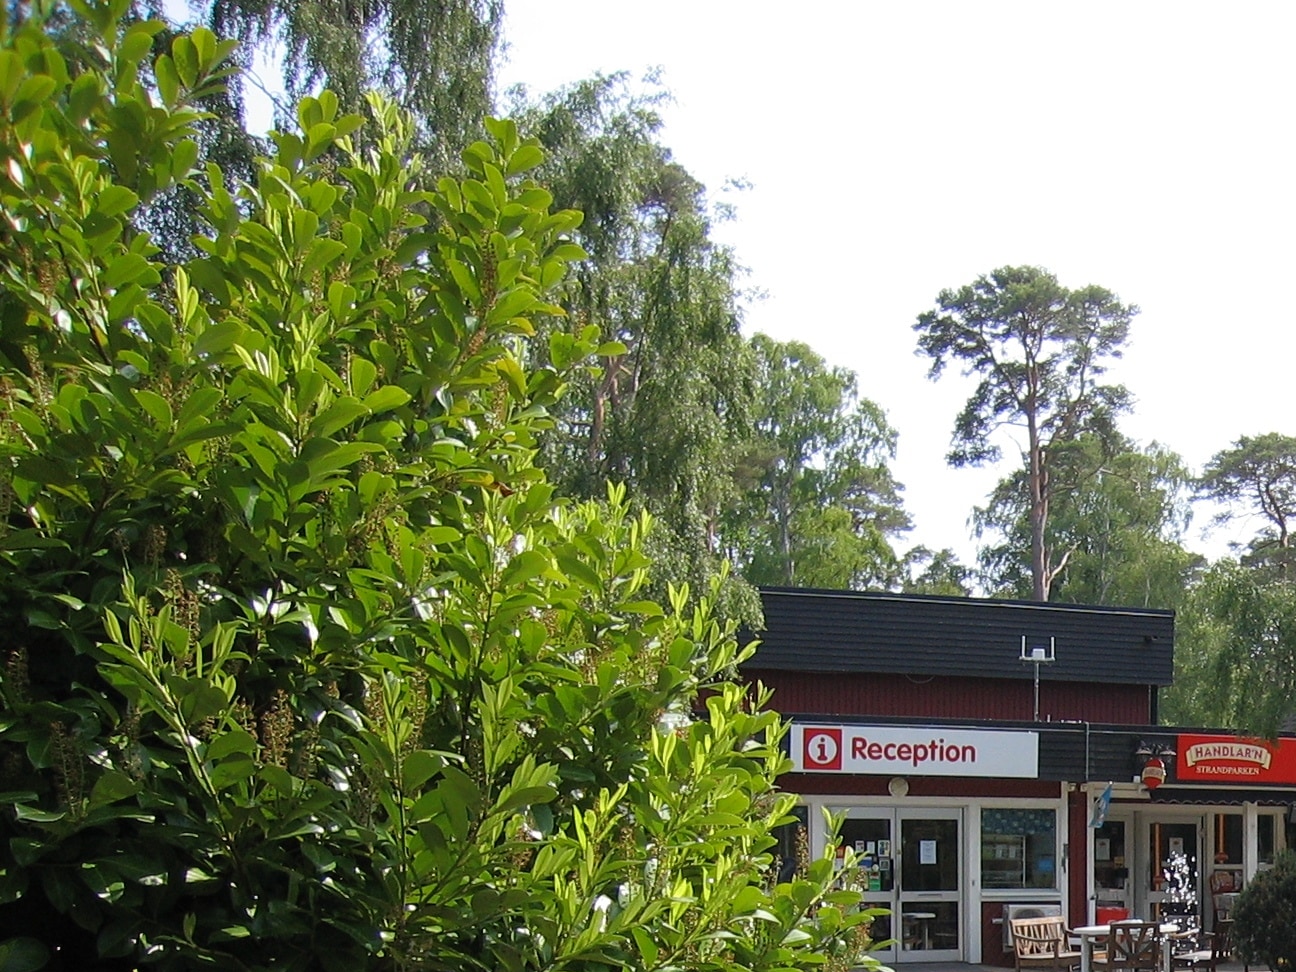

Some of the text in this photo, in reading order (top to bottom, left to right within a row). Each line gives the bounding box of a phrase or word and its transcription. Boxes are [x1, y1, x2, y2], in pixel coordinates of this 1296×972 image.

[851, 736, 976, 767] Reception
[1195, 746, 1263, 760] HANDLAR'N
[1195, 765, 1261, 775] STRANDPARKEN
